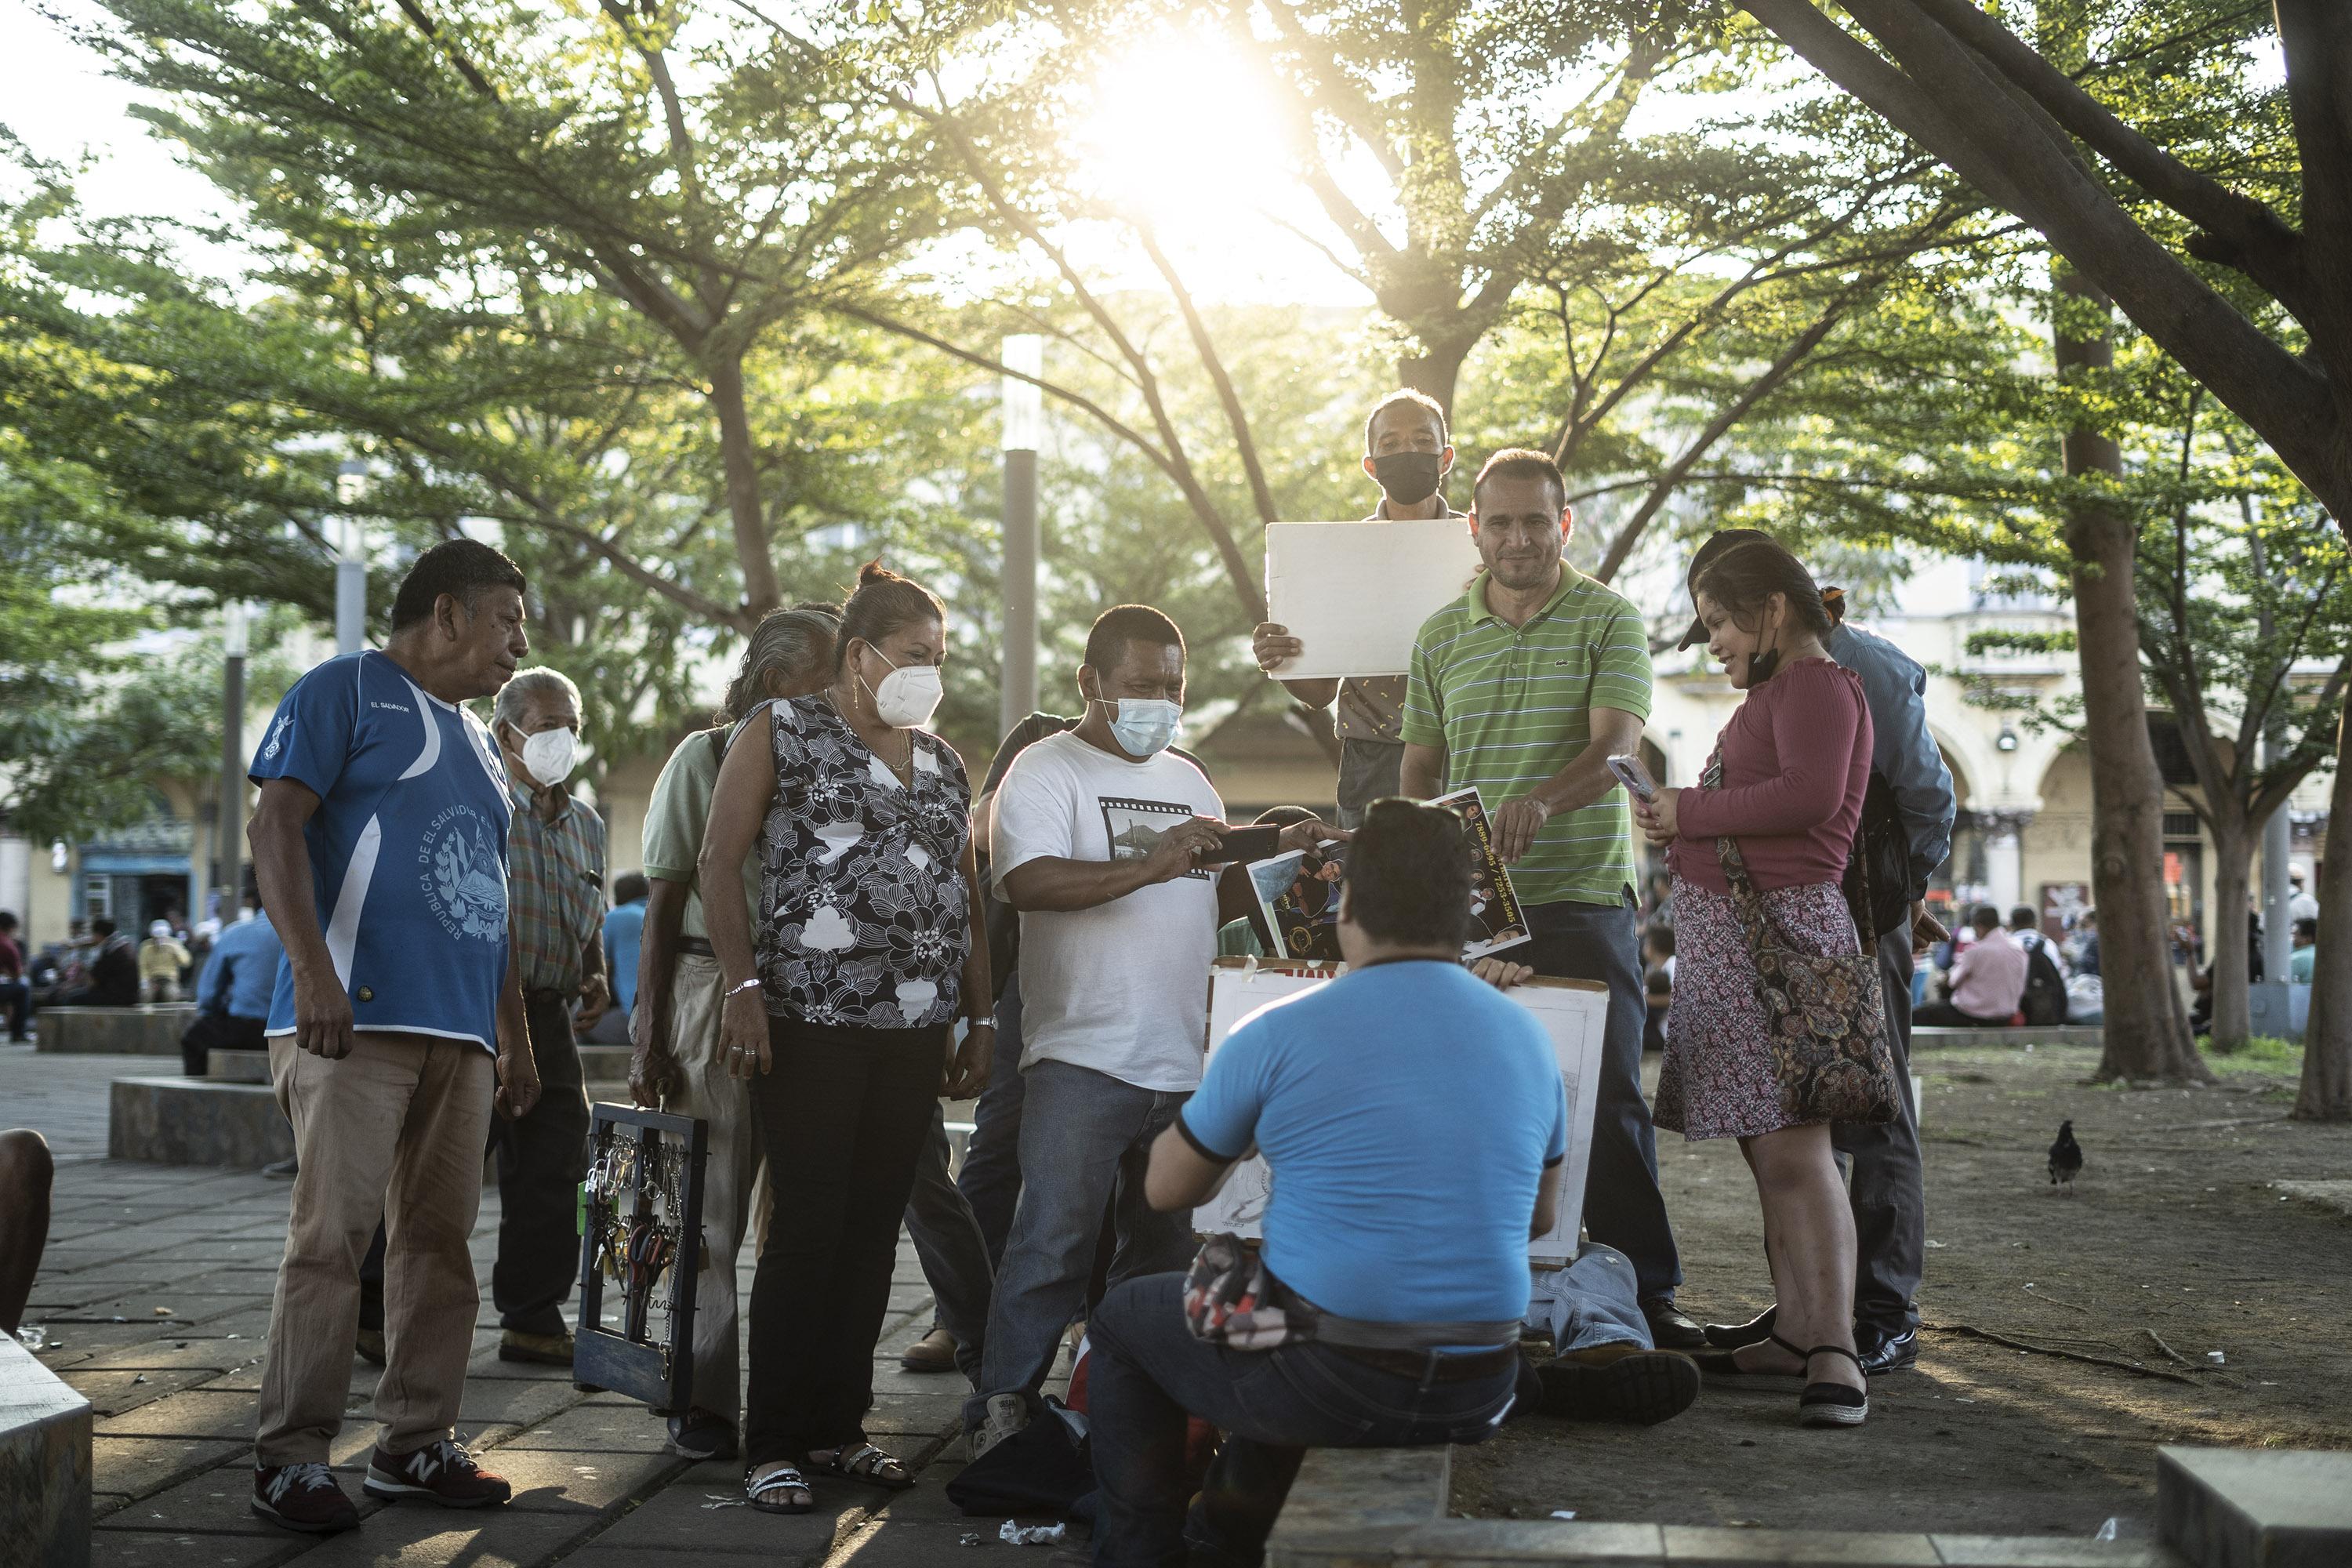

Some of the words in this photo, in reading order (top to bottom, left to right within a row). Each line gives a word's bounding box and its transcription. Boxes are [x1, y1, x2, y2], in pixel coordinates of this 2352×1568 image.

[380, 702, 410, 713] SALVADOR
[423, 830, 437, 845] EL
[419, 847, 430, 864] DE
[419, 873, 463, 941] REPUBLICA
[1494, 876, 1515, 923] 7253-3505
[405, 1450, 439, 1482] N
